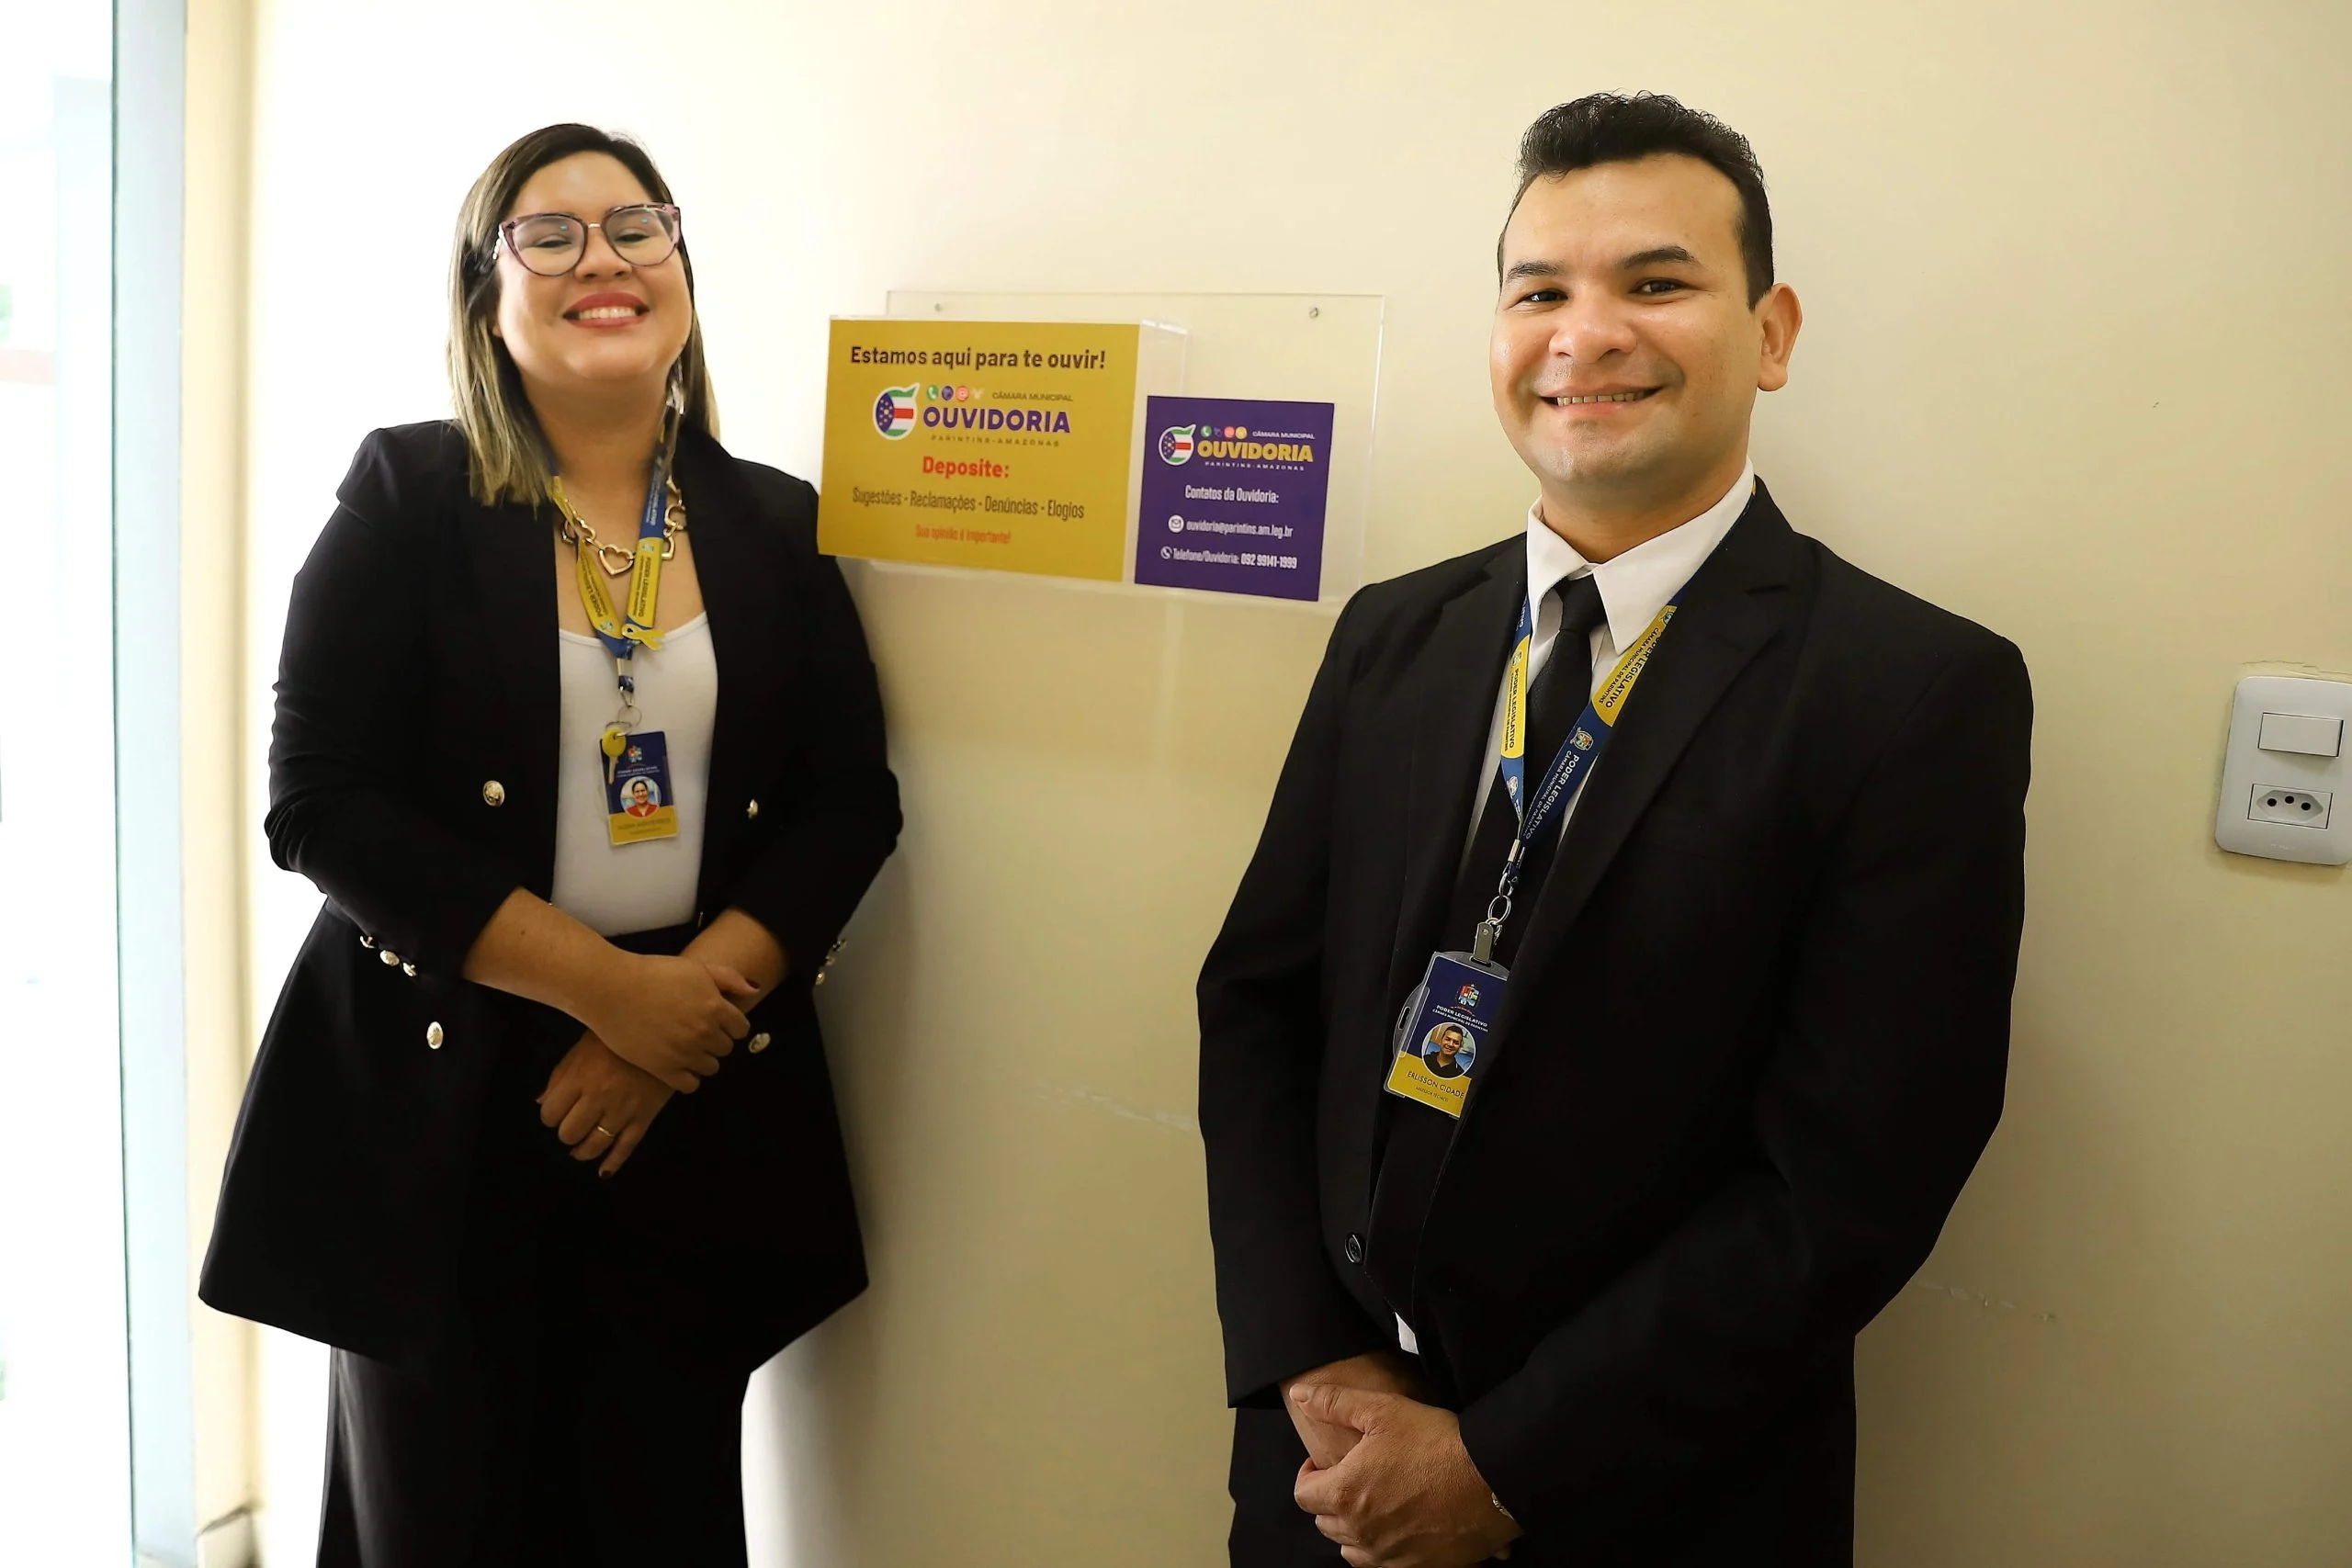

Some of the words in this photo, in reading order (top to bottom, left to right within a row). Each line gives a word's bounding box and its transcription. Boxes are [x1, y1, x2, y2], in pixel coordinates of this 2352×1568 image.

[851, 345, 927, 365] Estamos
[932, 346, 971, 369] aqui
[976, 352, 1018, 370] para
[1023, 350, 1043, 367] te
[1047, 349, 1105, 369] ouvir!
[991, 390, 1027, 400] CÂMARA
[1028, 392, 1073, 402] MUNICIPAL
[922, 406, 1071, 434] OUVIDORIA
[1252, 430, 1281, 439] CÂMARA
[1281, 432, 1316, 440] MUNICIPAL
[1197, 440, 1314, 463] OUVIDORIA
[922, 456, 1010, 479] Deposite:
[852, 487, 902, 507] Sugestões
[910, 490, 977, 513] Reclamações
[984, 495, 1038, 515] Denúncias
[1047, 499, 1085, 522] Elogios
[1185, 484, 1223, 501] Contatos
[1224, 487, 1236, 502] da
[1236, 488, 1280, 503] Ouvidoria:
[1186, 519, 1294, 539] ouvidoria@parintins.am.leg.br
[1172, 547, 1240, 565] Telefone/Ouvidoria:
[1240, 553, 1256, 566] 092
[1256, 554, 1298, 569] 99141-1999
[1622, 647, 1644, 672] MUNICIPAL
[1605, 657, 1648, 708] LEGISLATIVO
[1615, 670, 1624, 680] DE
[1598, 679, 1619, 705] PARINTINS
[1509, 695, 1517, 749] LEGISLATIVO
[1556, 750, 1572, 773] CÂMARA
[1557, 754, 1580, 785] PODER
[1540, 773, 1559, 800] MUNICIPAL
[1525, 784, 1562, 840] LEGISLATIVO
[1436, 1005, 1455, 1015] PODER
[1454, 1011, 1487, 1027] LEGISLATIVO
[1407, 1070, 1439, 1089] ERLISSON
[1439, 1084, 1465, 1100] CIDADE
